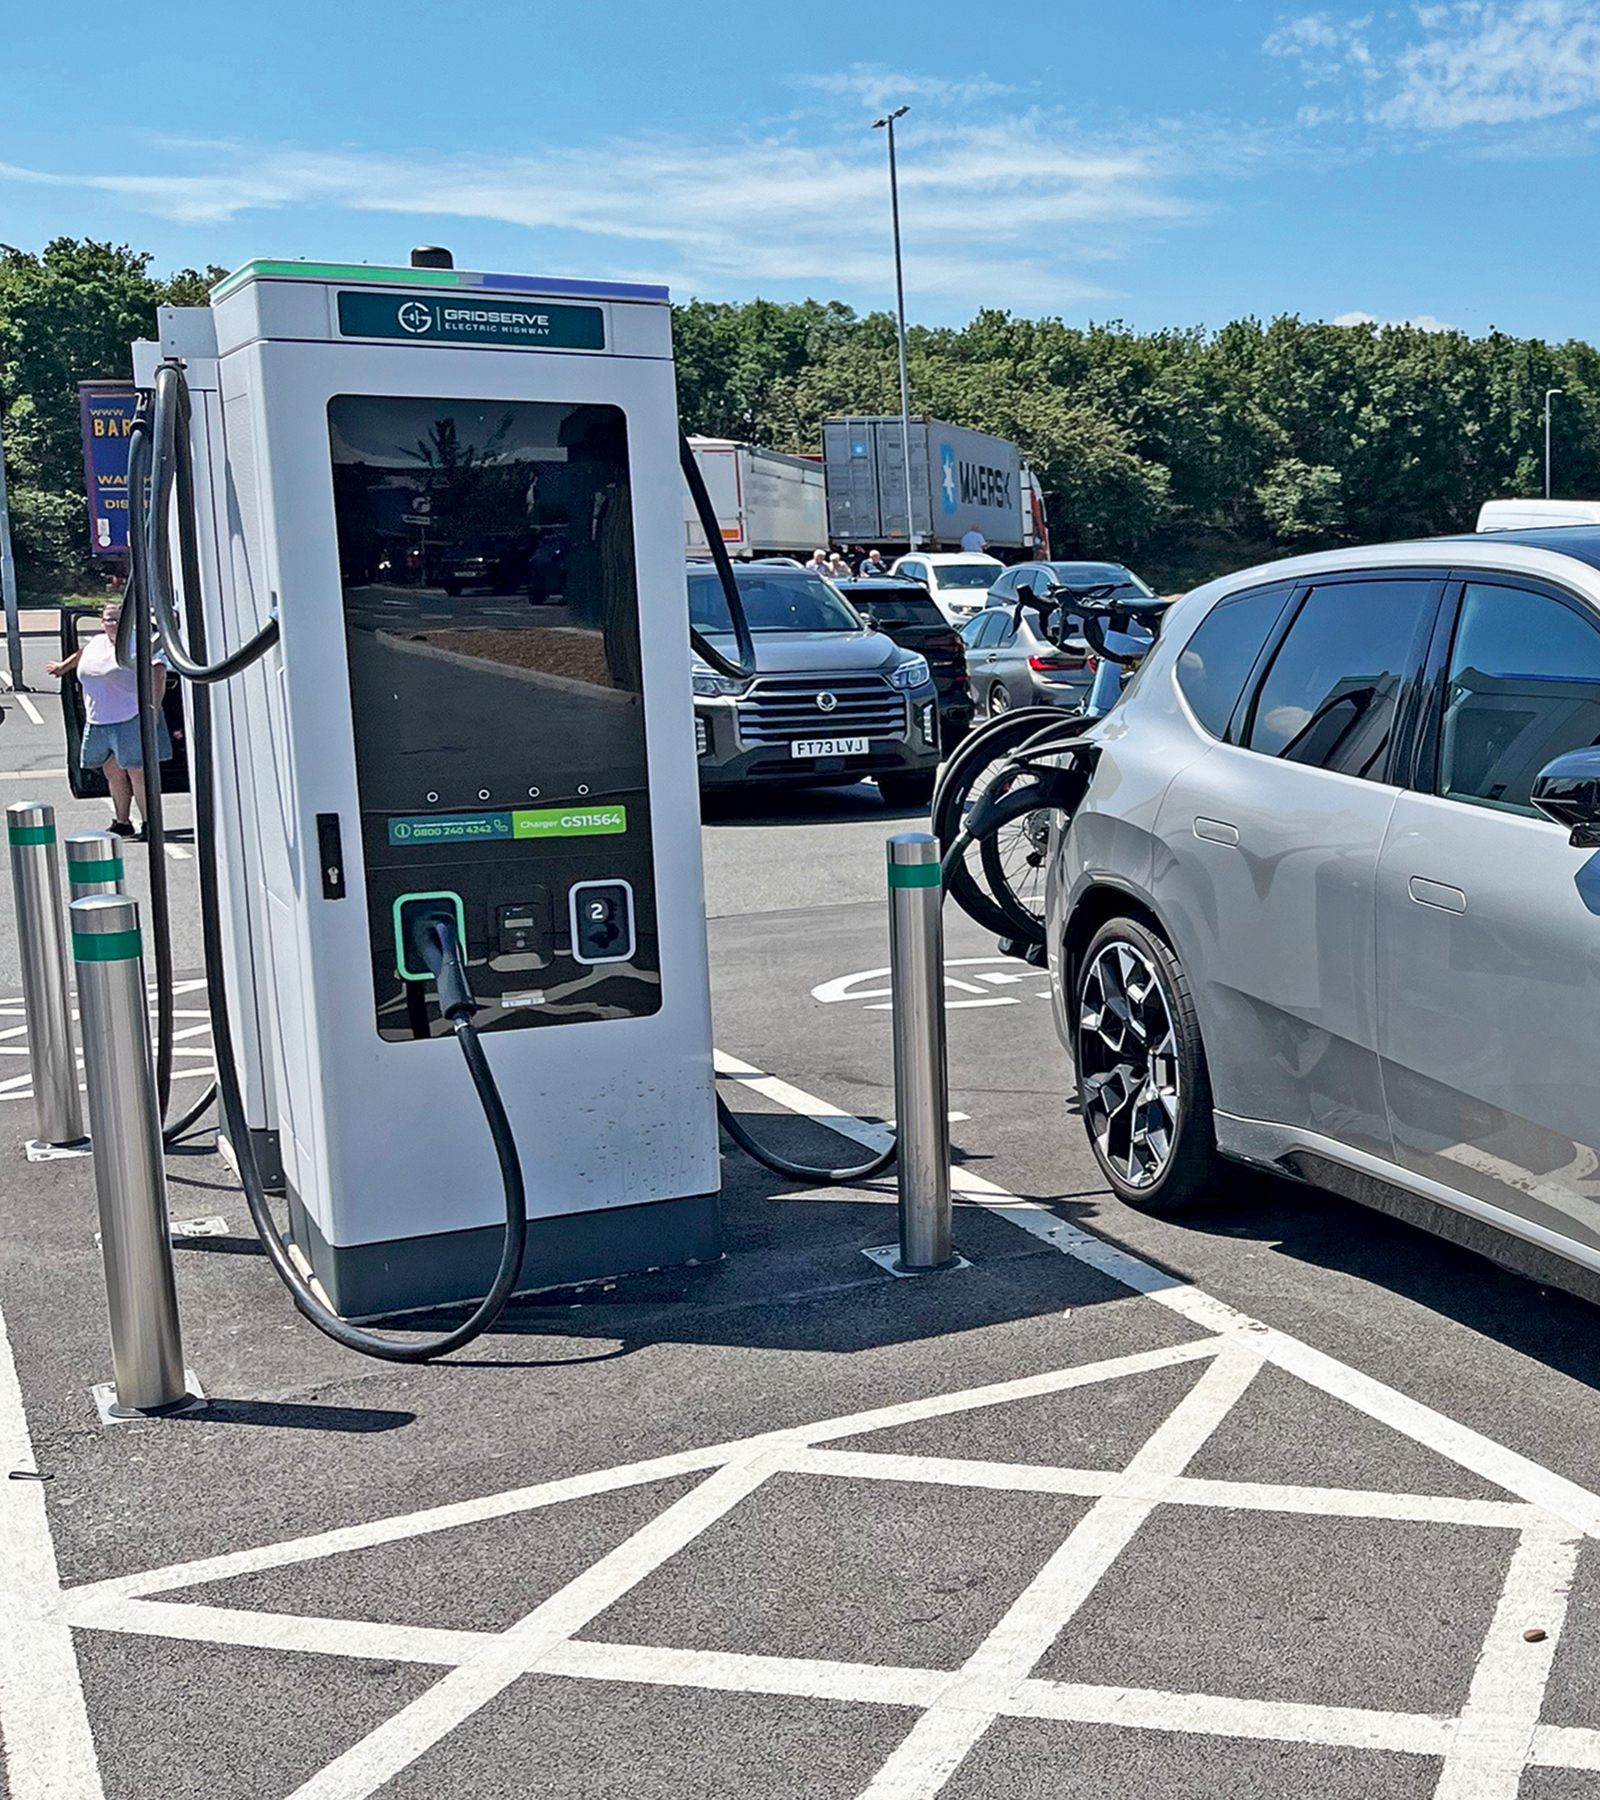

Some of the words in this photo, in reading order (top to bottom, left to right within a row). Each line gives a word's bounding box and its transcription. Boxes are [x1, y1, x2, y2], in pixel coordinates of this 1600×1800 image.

[444, 309, 549, 325] GRIDSERVE
[444, 322, 498, 333] ELECTRIC
[501, 327, 550, 336] HIGHWAY
[959, 460, 1013, 510] MAERSK
[797, 740, 834, 756] FT73
[836, 739, 863, 754] LVJ
[520, 820, 558, 829] Charger
[560, 813, 621, 828] GS11564
[413, 828, 442, 837] 0800
[443, 826, 464, 835] 240
[465, 824, 492, 834] 4242
[591, 903, 604, 919] 2
